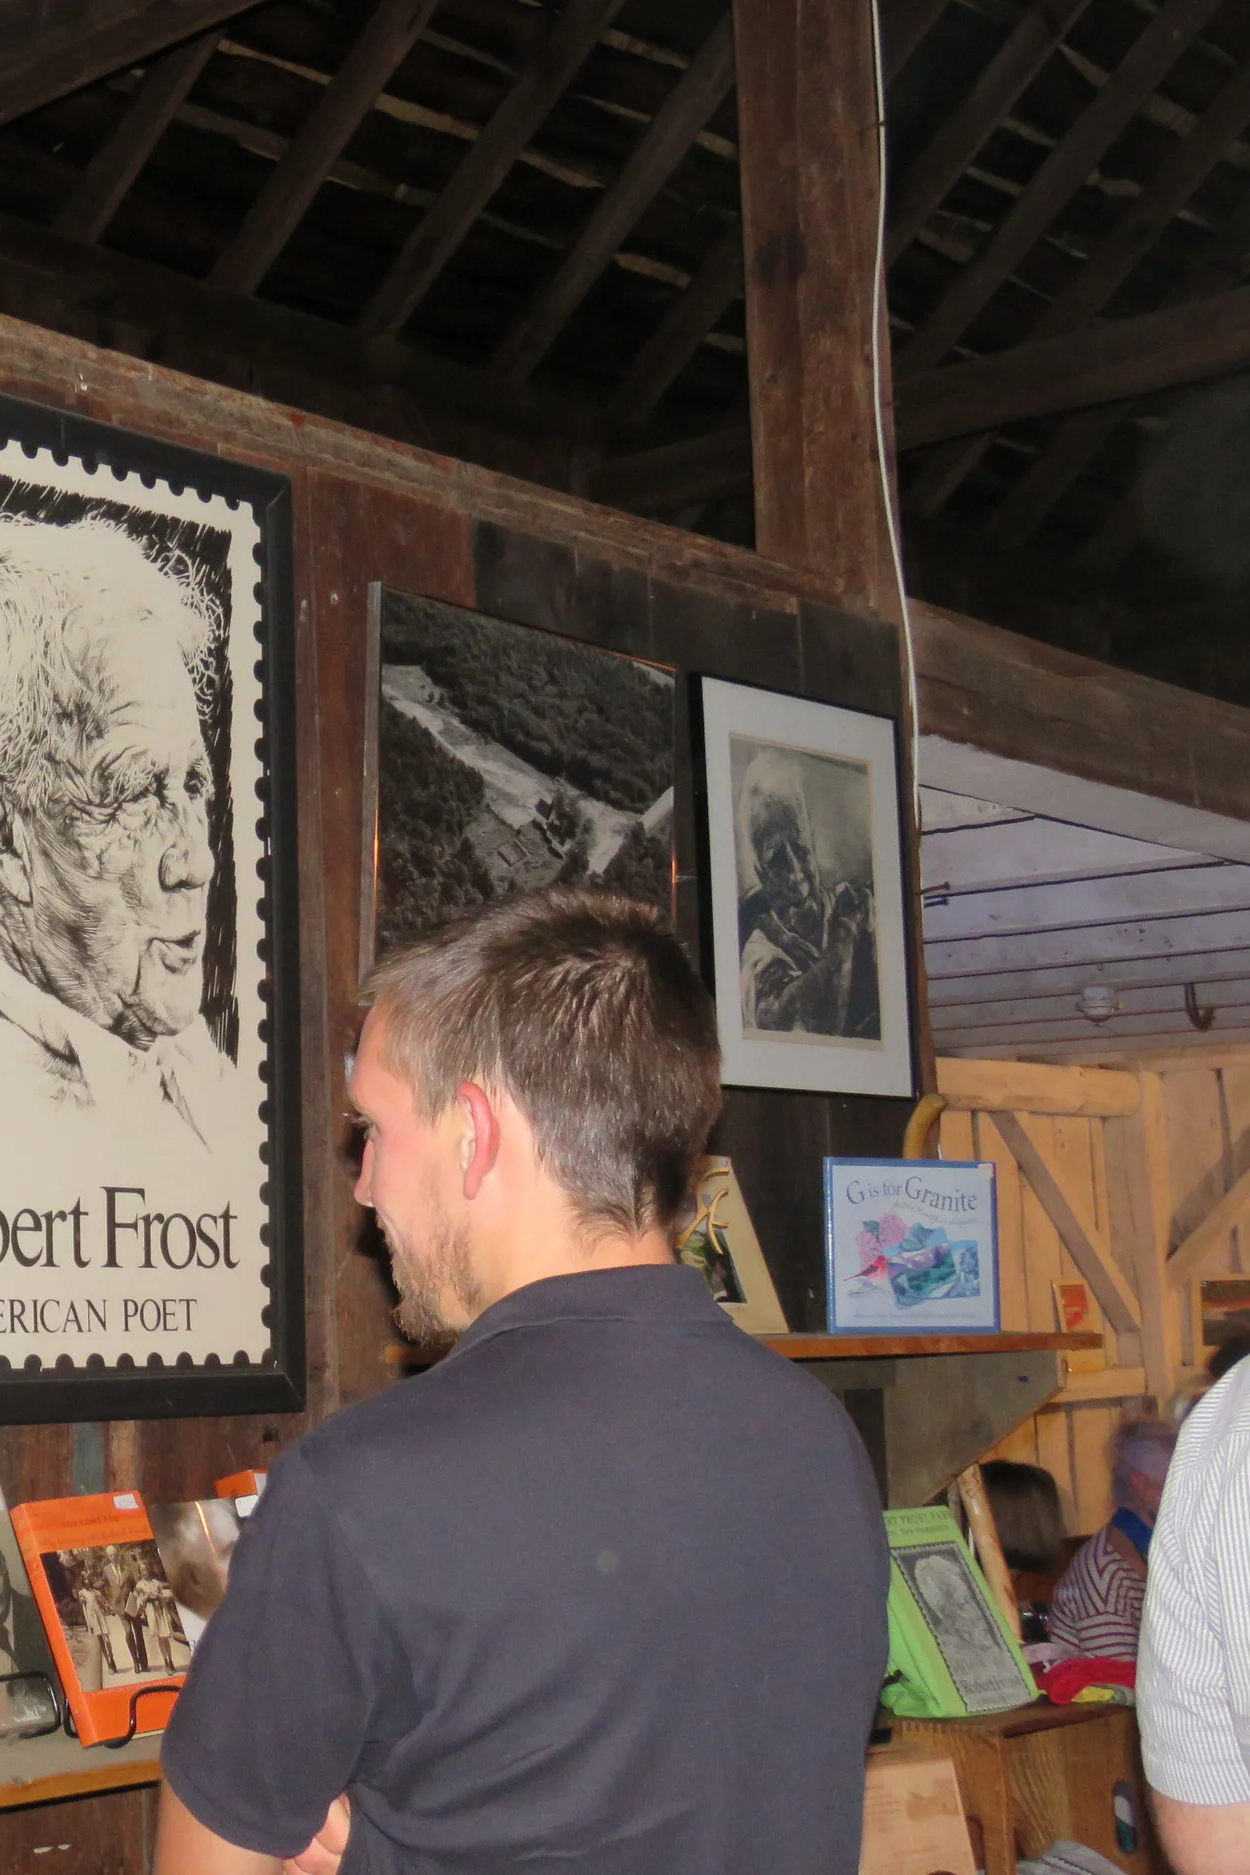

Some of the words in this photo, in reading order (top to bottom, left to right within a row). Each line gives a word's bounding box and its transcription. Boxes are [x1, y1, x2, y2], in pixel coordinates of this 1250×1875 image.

[846, 1180, 866, 1205] G
[868, 1183, 880, 1197] is
[882, 1178, 903, 1197] for
[904, 1176, 978, 1213] Granite
[99, 1186, 240, 1270] Frost
[122, 1299, 198, 1332] POET
